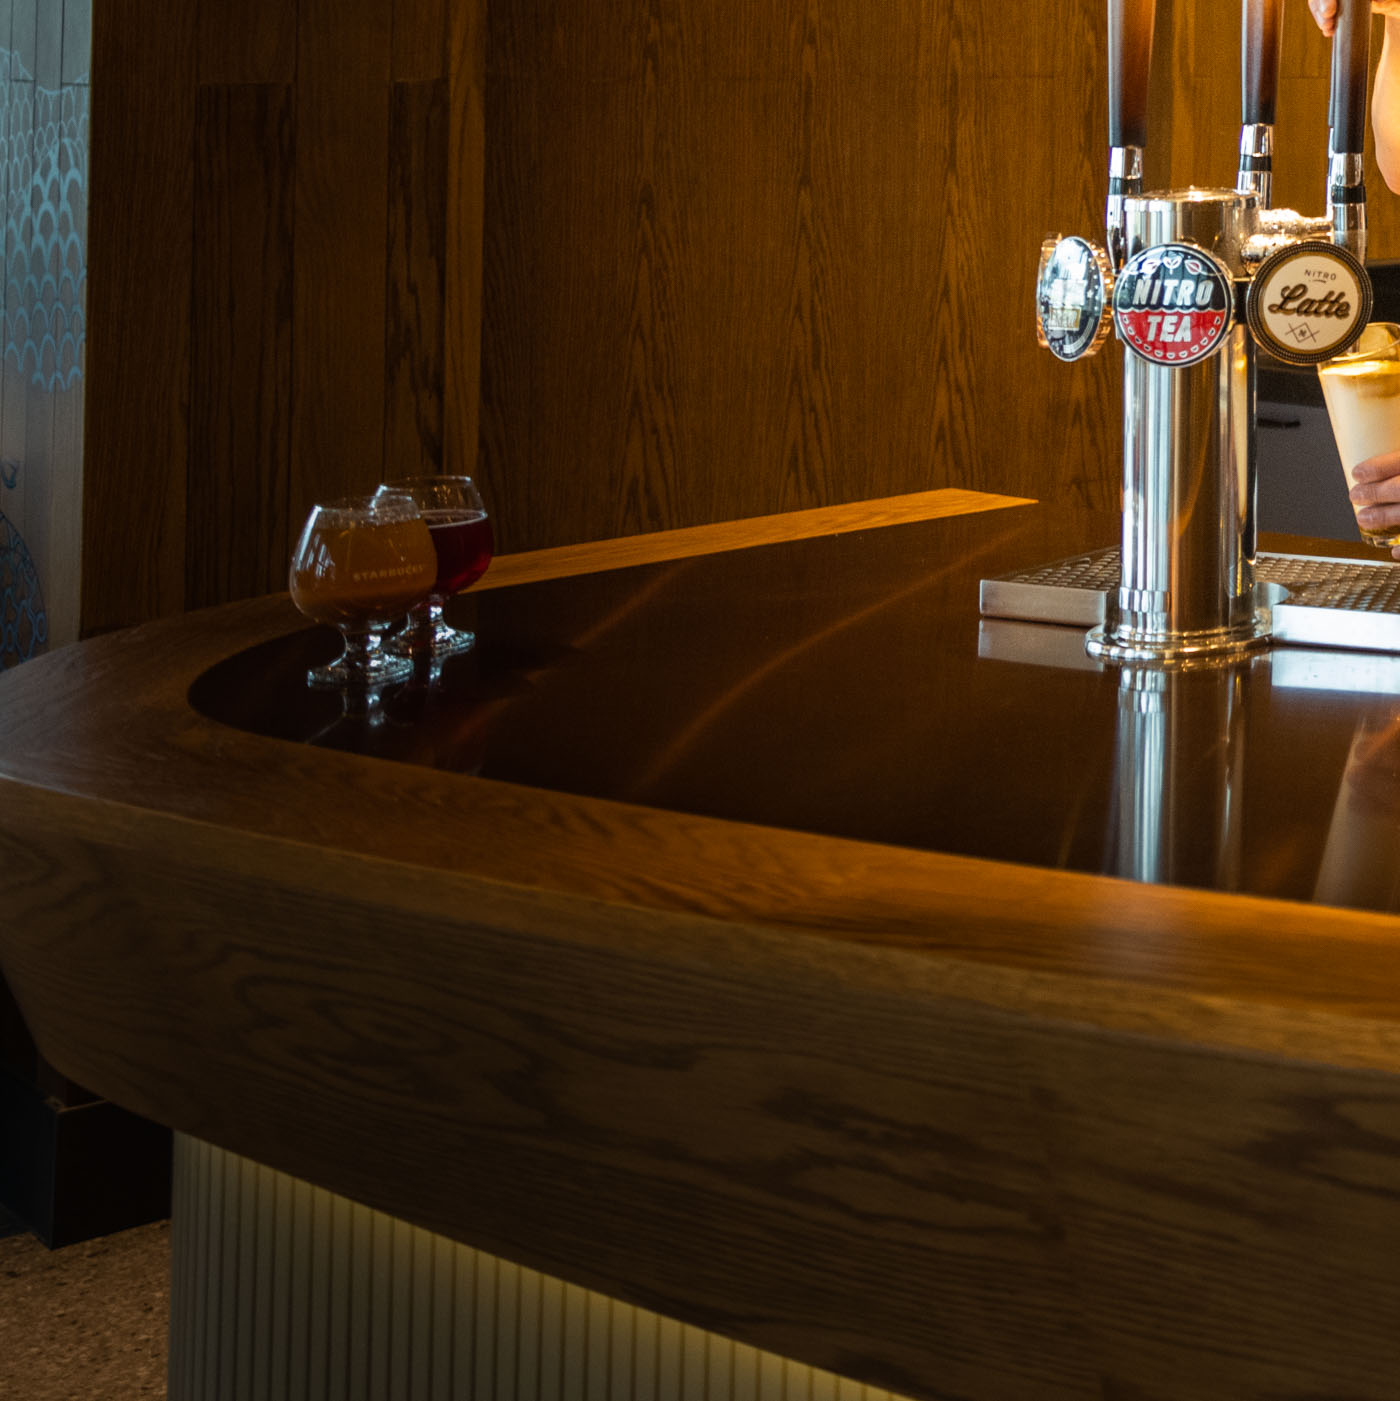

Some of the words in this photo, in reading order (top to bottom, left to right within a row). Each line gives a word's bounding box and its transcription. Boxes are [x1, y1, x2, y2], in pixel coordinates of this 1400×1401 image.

[1305, 269, 1337, 281] NITRO
[1132, 278, 1215, 306] NITRO
[1268, 283, 1351, 319] Latte
[1147, 314, 1193, 344] TEA
